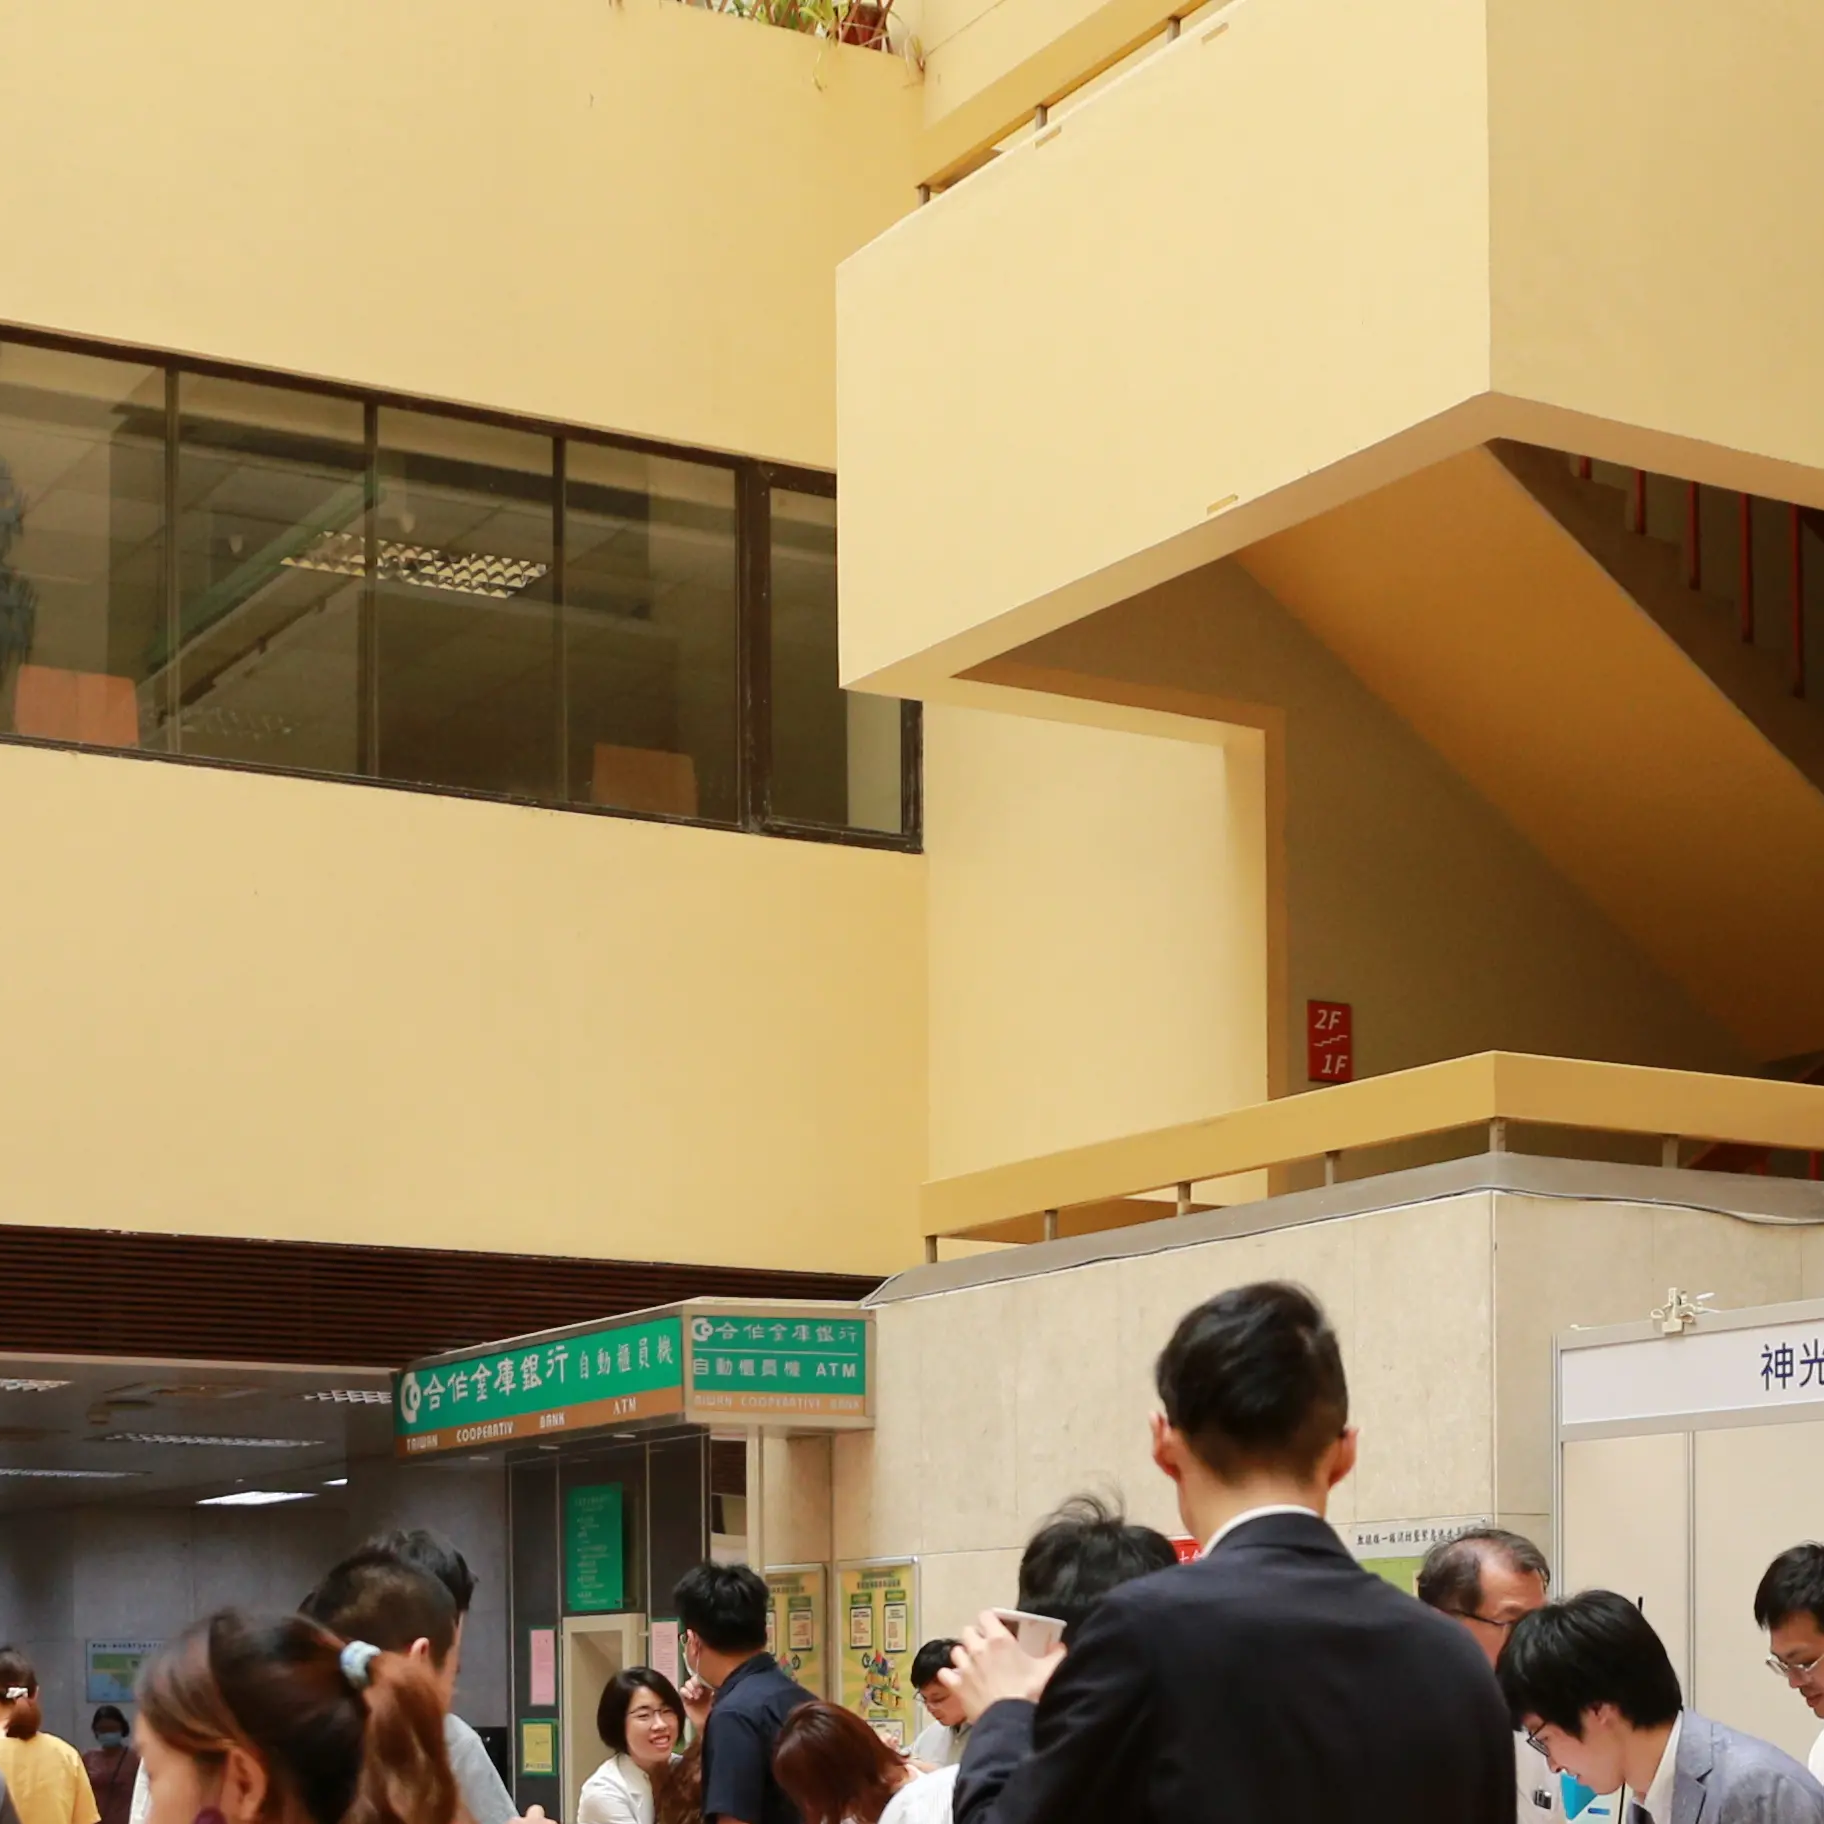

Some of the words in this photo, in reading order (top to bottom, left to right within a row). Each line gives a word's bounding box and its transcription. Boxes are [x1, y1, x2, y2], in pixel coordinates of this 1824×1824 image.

[1314, 1009, 1341, 1030] 2F
[1321, 1054, 1348, 1075] 1F
[715, 1322, 857, 1343] 合作金庫銀行
[423, 1345, 569, 1411] 合作金庫銀行
[579, 1335, 673, 1380] 自動櫃員機
[694, 1358, 801, 1378] 自動櫃員機
[815, 1362, 857, 1378] ATM
[539, 1412, 565, 1429] BANK
[613, 1397, 637, 1416] ATM
